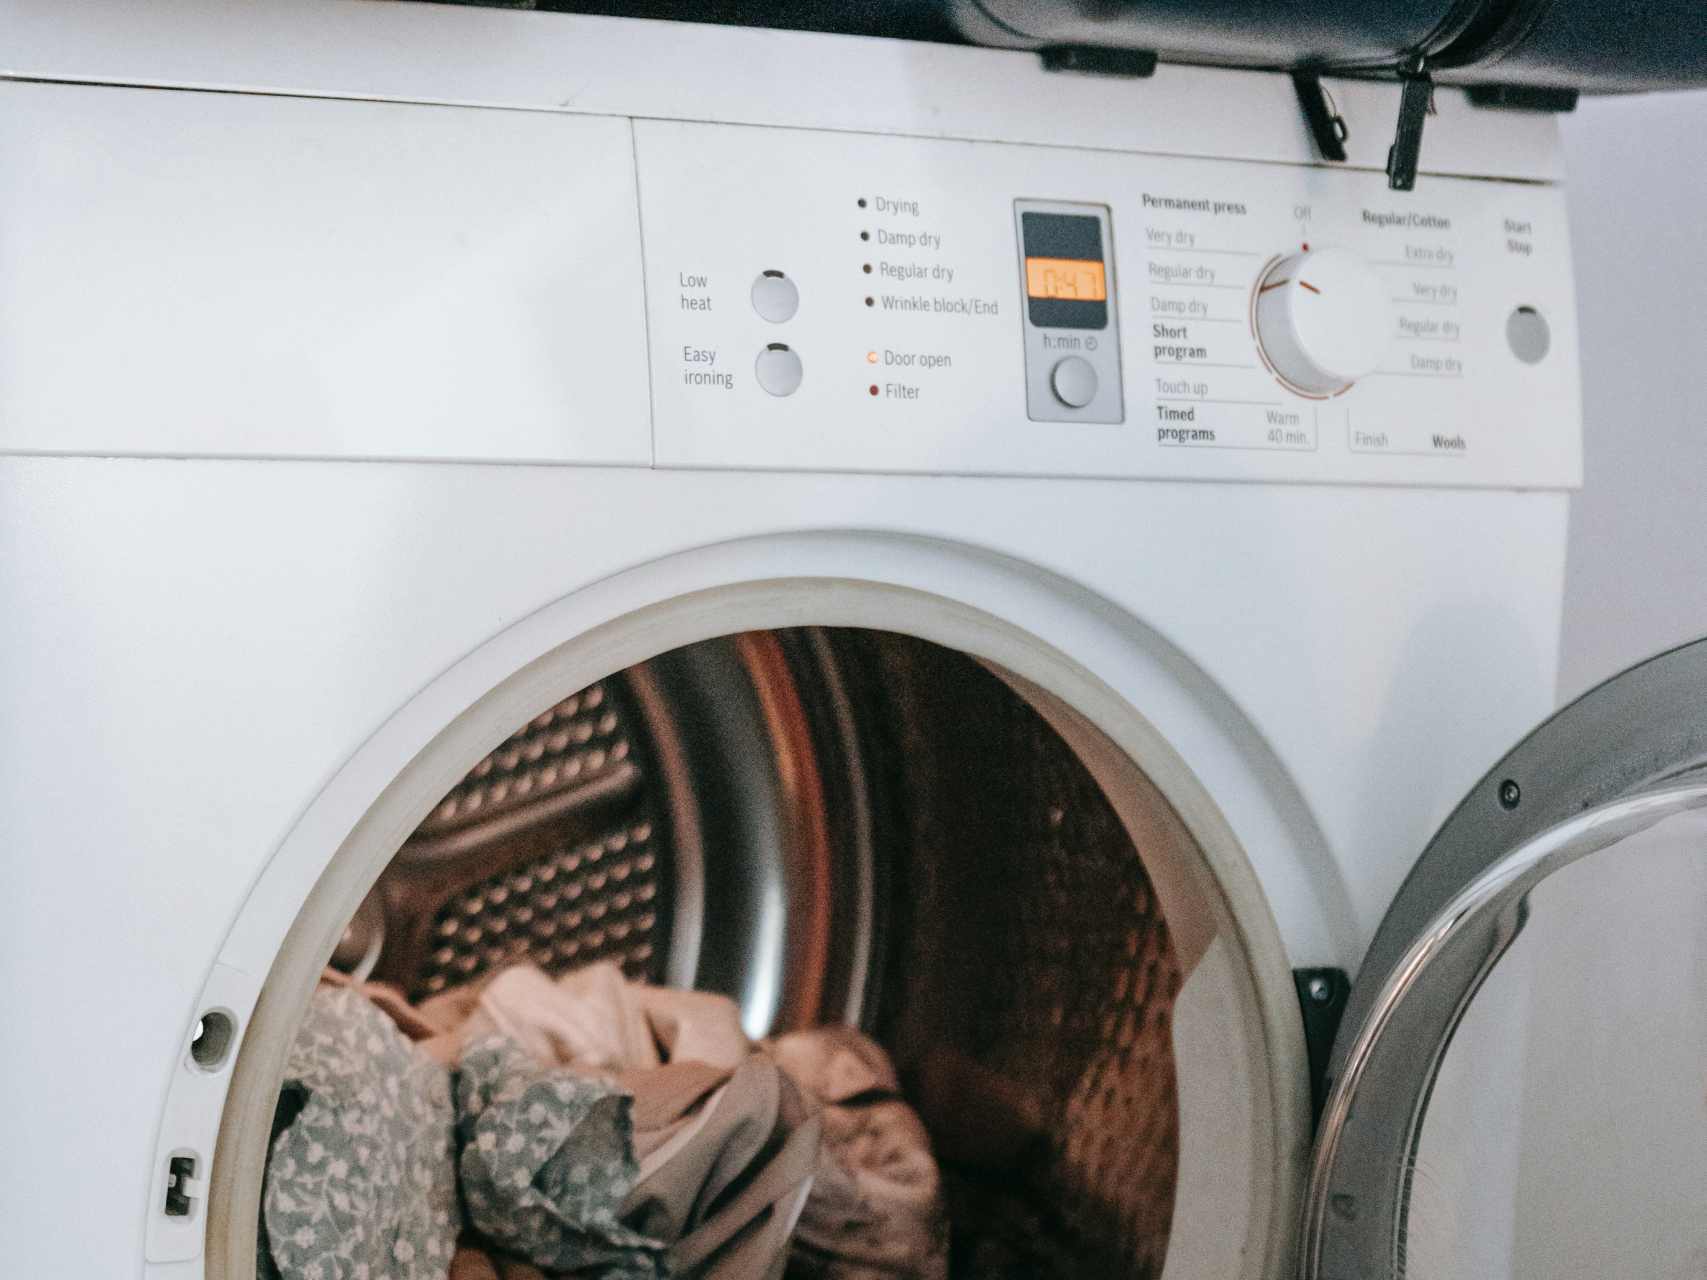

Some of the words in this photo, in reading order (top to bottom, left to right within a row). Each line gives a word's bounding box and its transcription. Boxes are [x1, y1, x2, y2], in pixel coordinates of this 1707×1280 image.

[876, 197, 919, 217] Drying
[1142, 193, 1211, 211] Permanent
[1214, 201, 1247, 215] press
[1294, 206, 1312, 220] Off
[1363, 210, 1451, 228] Regular/Cotton
[1505, 218, 1532, 234] Start
[878, 230, 916, 247] Damp
[919, 233, 941, 250] dry
[1146, 228, 1172, 246] Very
[1176, 230, 1195, 246] dry
[1406, 245, 1434, 260] Extra
[1437, 247, 1454, 265] dry
[1508, 239, 1533, 255] Stop
[680, 273, 708, 288] Low
[880, 263, 929, 281] Regular
[932, 265, 954, 283] dry
[1149, 262, 1193, 281] Regular
[1197, 265, 1216, 283] dry
[1413, 282, 1437, 297] Very
[1440, 285, 1458, 301] dry
[681, 295, 712, 311] heat
[882, 296, 931, 313] Wrinkle
[934, 298, 999, 316] block/End
[1152, 297, 1186, 315] Damp
[1189, 300, 1208, 316] dry
[1153, 324, 1187, 340] Short
[1400, 318, 1439, 335] Regular
[1442, 320, 1460, 339] dry
[1044, 334, 1081, 349] h:min
[684, 347, 716, 366] Easy
[885, 351, 916, 367] Door
[920, 355, 952, 370] open
[1155, 345, 1207, 361] program
[1412, 355, 1443, 370] Damp
[1446, 357, 1463, 373] dry
[685, 370, 734, 389] ironing
[1156, 378, 1190, 394] Touch
[1194, 383, 1208, 398] up
[886, 384, 920, 399] Filter
[1157, 406, 1195, 421] Timed
[1267, 411, 1300, 425] Warm
[1158, 427, 1216, 443] programs
[1268, 429, 1283, 443] 40
[1286, 431, 1310, 445] min.
[1356, 432, 1388, 446] Finish
[1433, 434, 1466, 450] Wools
